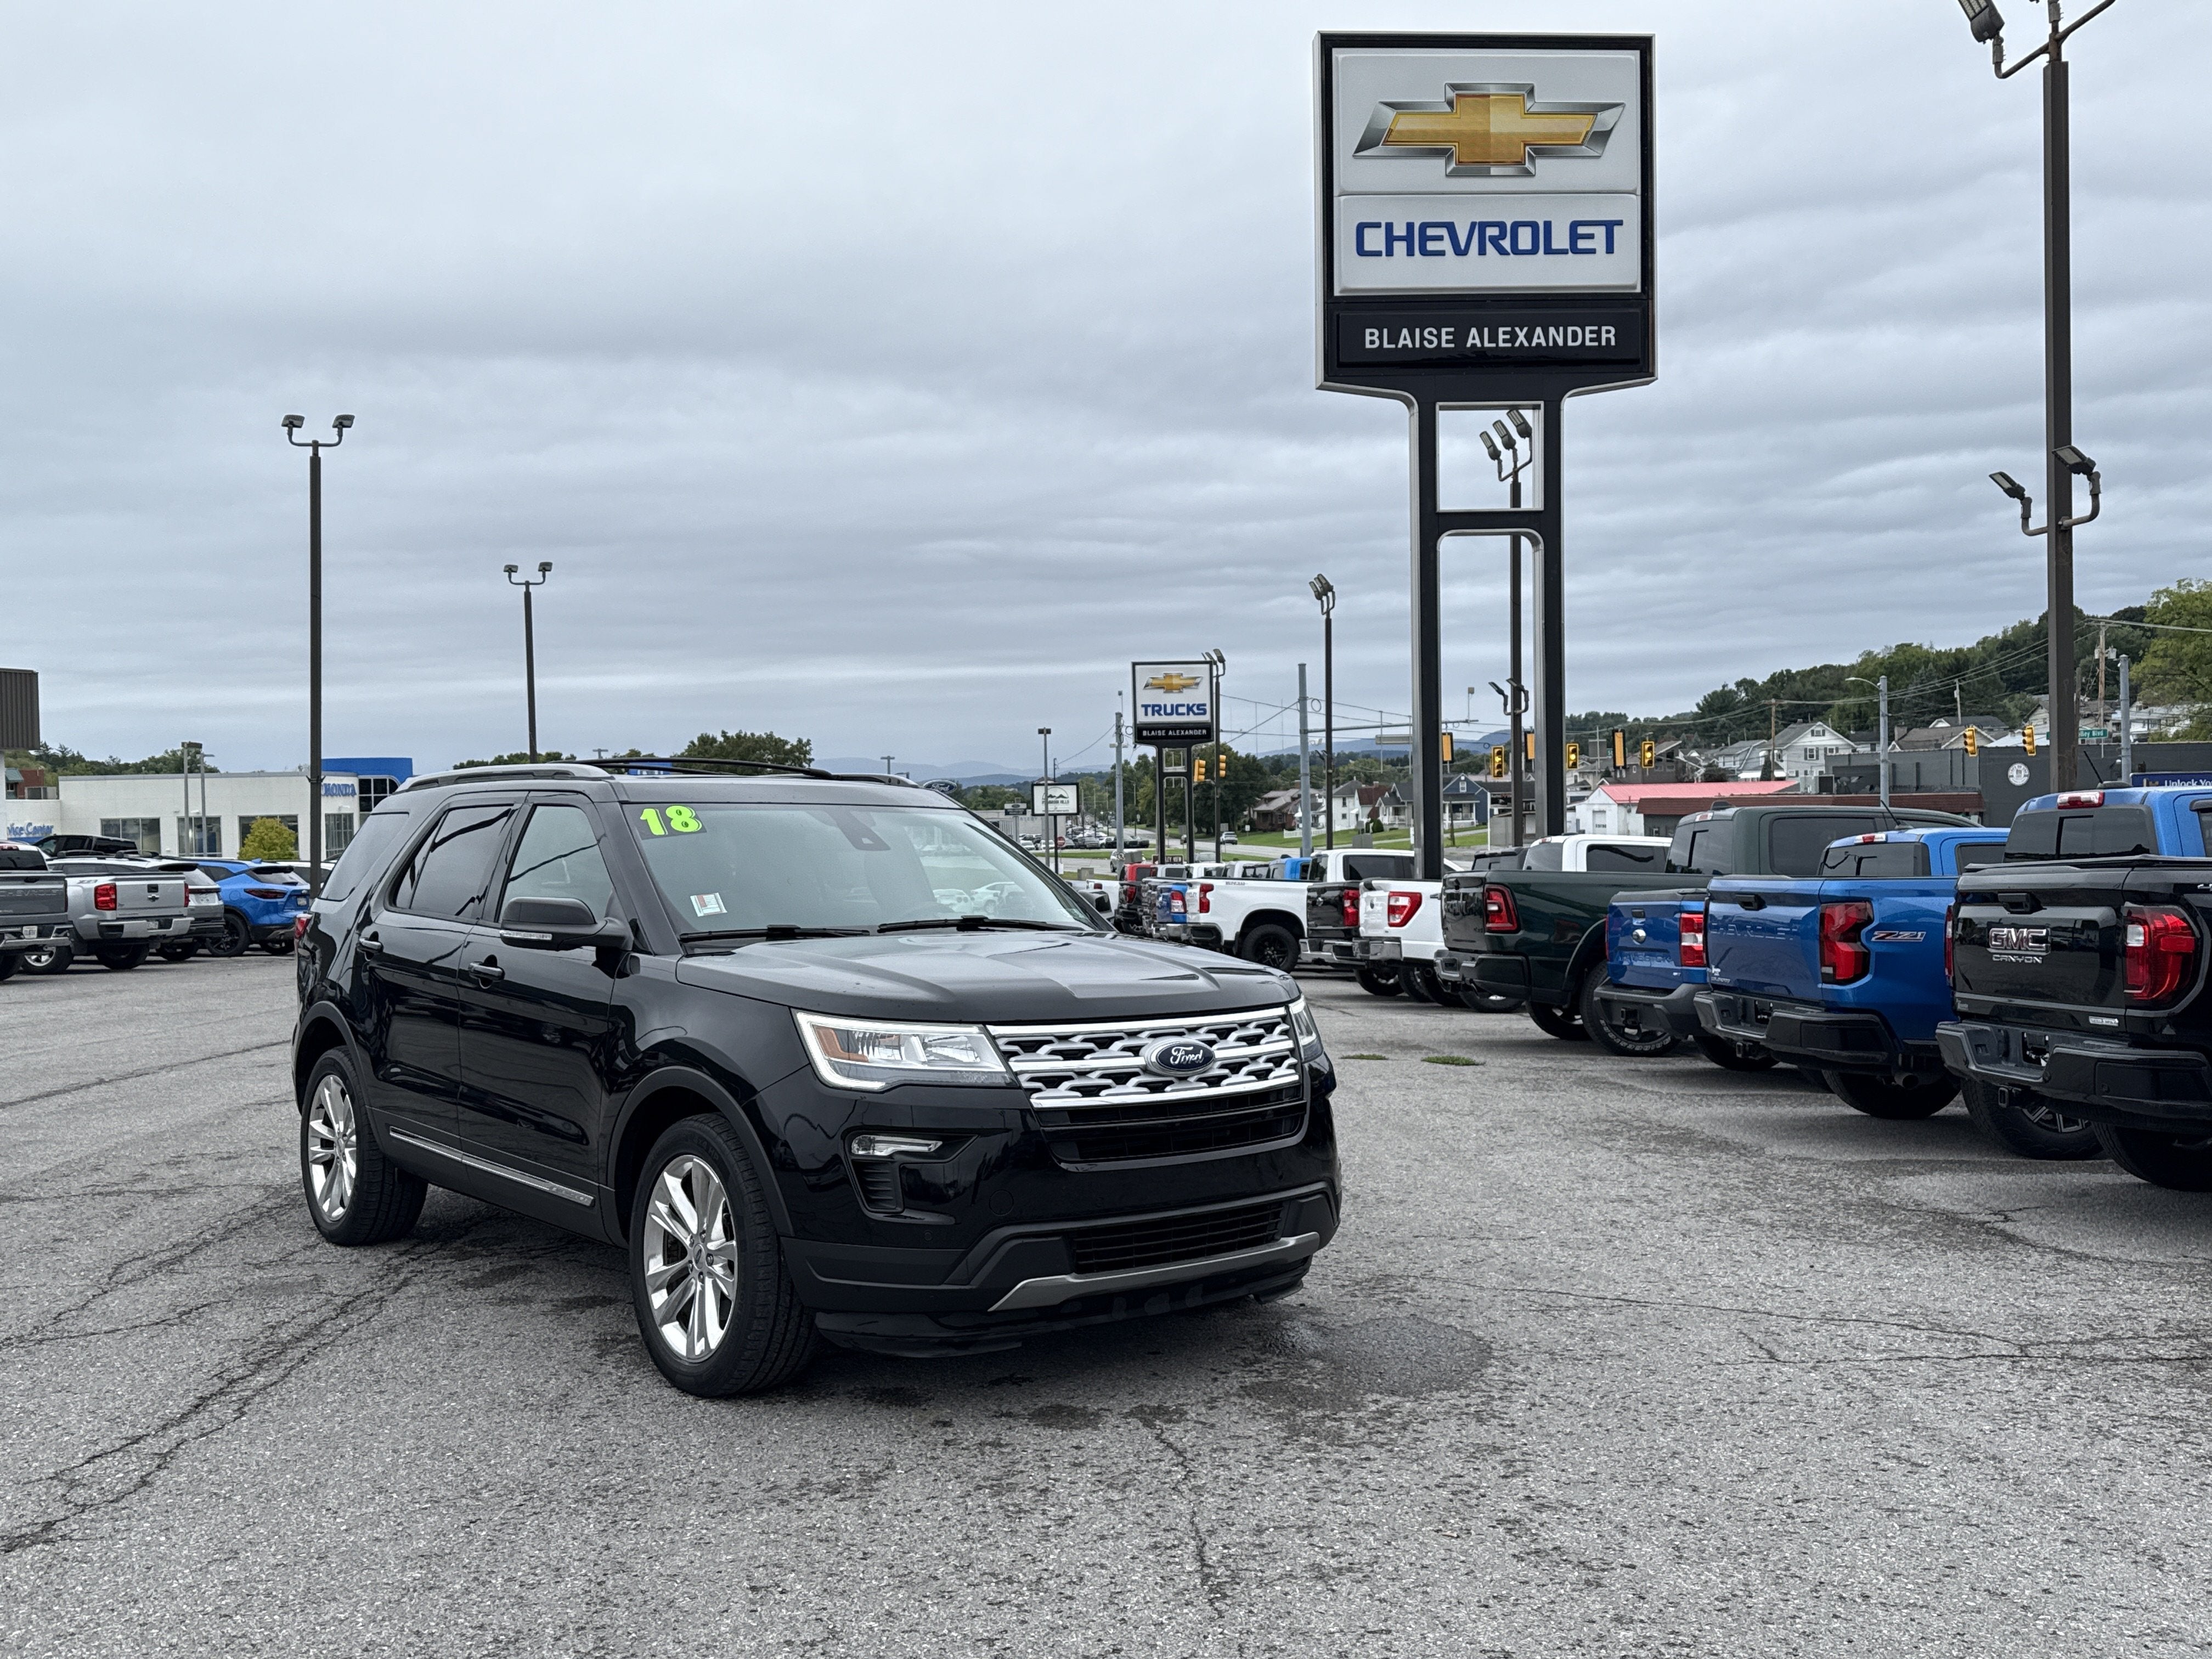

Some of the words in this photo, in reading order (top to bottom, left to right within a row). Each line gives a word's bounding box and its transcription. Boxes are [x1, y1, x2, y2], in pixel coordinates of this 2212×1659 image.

[1356, 219, 1624, 257] CHEVROLET
[1364, 327, 1455, 349] BLAISE
[1466, 326, 1616, 348] ALEXANDER
[1141, 703, 1207, 716] TRUCKS
[322, 783, 357, 797] HONDA
[26, 822, 54, 835] Center
[640, 805, 703, 836] 18
[1989, 928, 2047, 951] GMC
[1992, 954, 2043, 964] CANYON
[1170, 1046, 1205, 1065] Ford
